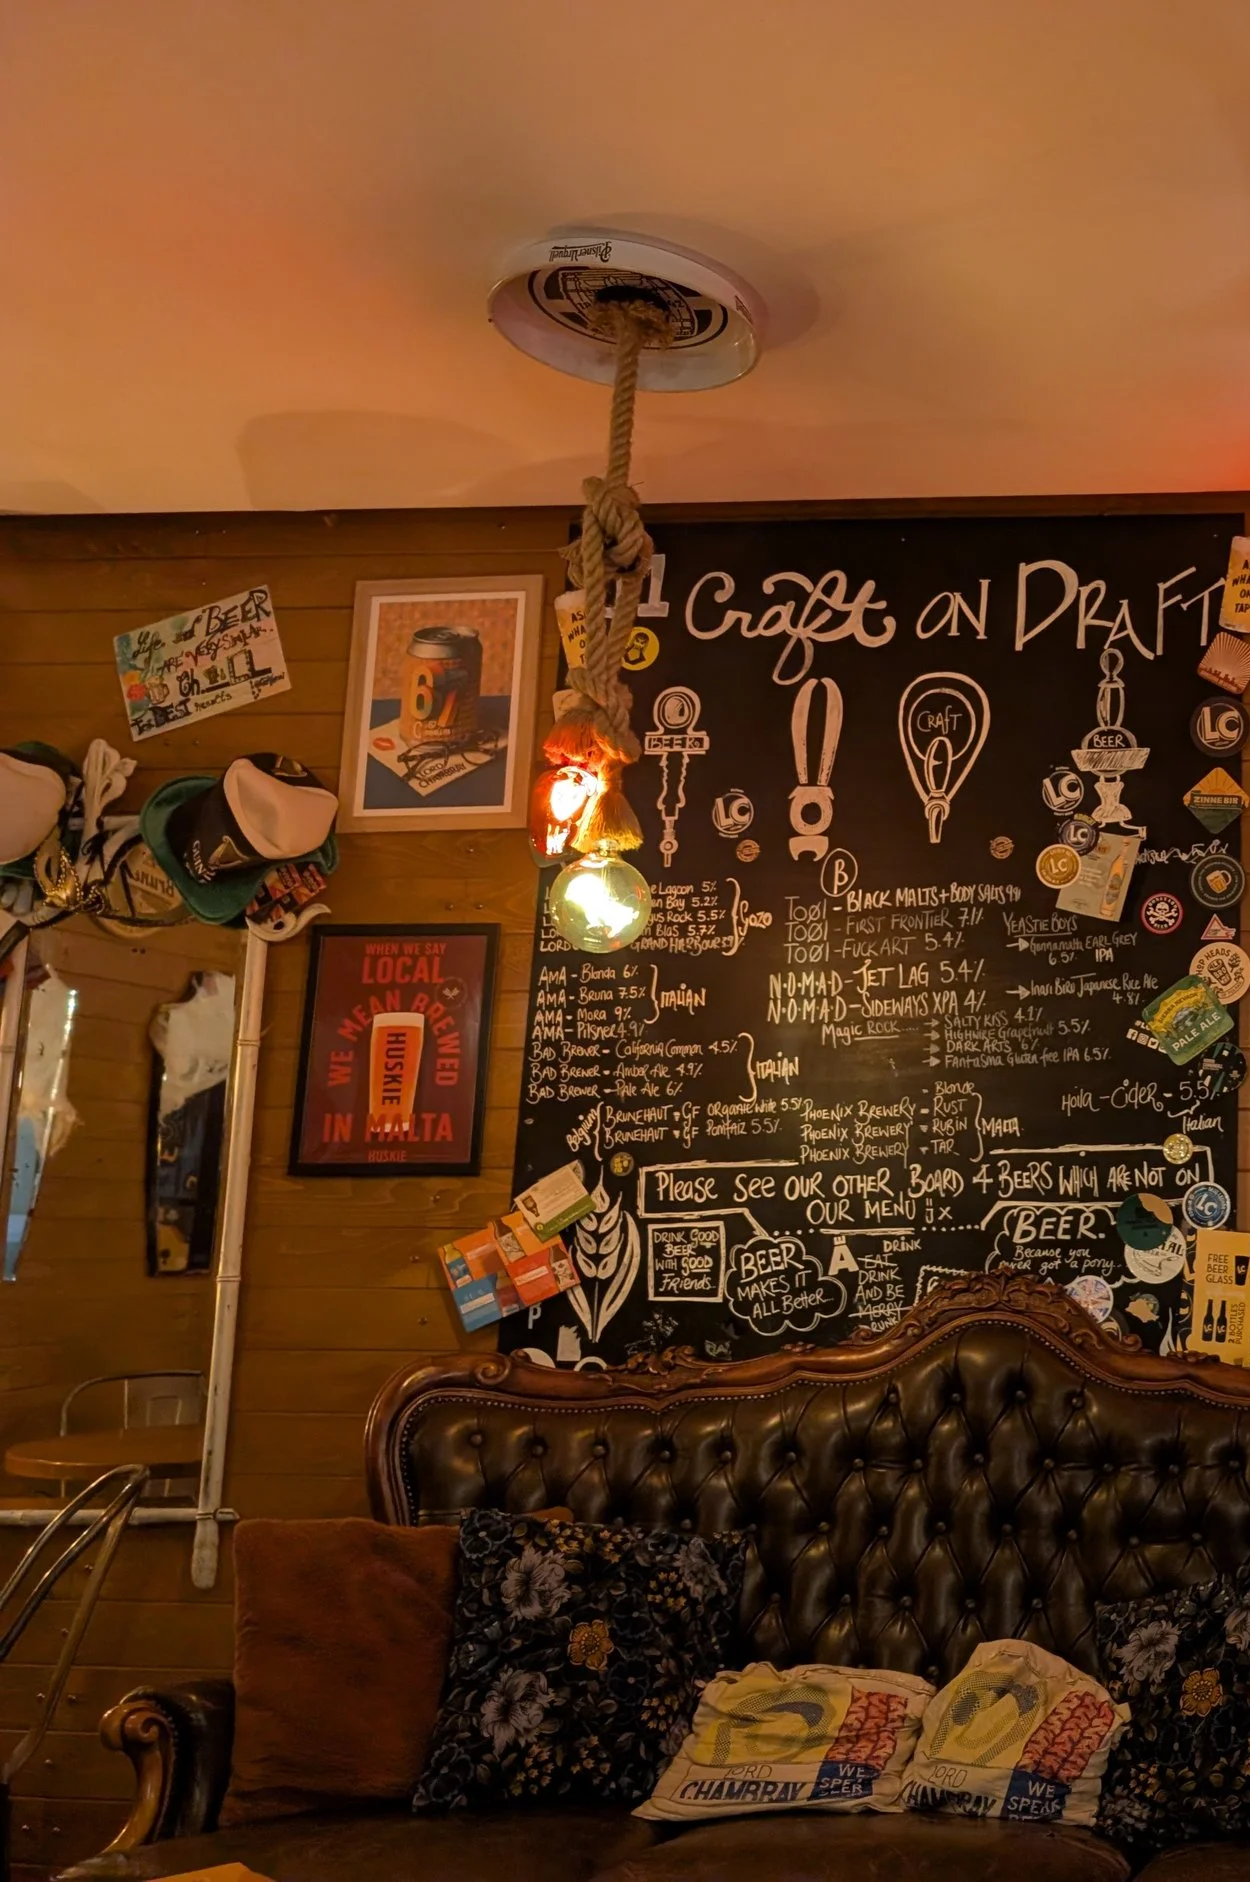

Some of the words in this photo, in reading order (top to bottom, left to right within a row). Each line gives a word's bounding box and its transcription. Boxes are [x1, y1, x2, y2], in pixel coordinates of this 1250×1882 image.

[549, 244, 579, 262] Urquell
[578, 241, 612, 263] Pilsner
[685, 569, 896, 684] Craft
[915, 578, 992, 639] ON
[1015, 560, 1226, 660] DRAFT
[1202, 705, 1240, 743] LC
[1094, 735, 1125, 748] BEER
[1043, 773, 1080, 808] LC
[714, 797, 751, 830] LC
[1067, 824, 1088, 842] LC
[1050, 857, 1067, 874] LC
[1085, 934, 1111, 949] EARL
[1111, 930, 1138, 947] GREY
[365, 943, 399, 956] WHEN
[403, 943, 419, 955] WE
[425, 943, 447, 955] SAY
[1094, 948, 1114, 963] IPA
[1205, 947, 1232, 960] HEADS
[362, 956, 445, 984] LOCAL
[852, 959, 895, 994] JET
[899, 962, 929, 989] LAG
[860, 991, 929, 1018] SIDEWAYS
[932, 989, 959, 1016] XPA
[337, 989, 400, 1042] MEAN
[411, 992, 462, 1086] BREWED
[1171, 1027, 1200, 1052] PALE
[1199, 1011, 1222, 1031] ALE
[328, 1050, 353, 1087] WE
[382, 1032, 407, 1106] HUSKIE
[932, 1096, 968, 1117] RUST
[322, 1113, 353, 1143] IN
[364, 1113, 453, 1143] MALTA
[368, 1150, 407, 1163] HUSKIE
[930, 1138, 960, 1156] TAR
[783, 1170, 826, 1201] OUR
[832, 1166, 895, 1198] OTHER
[907, 1163, 965, 1198] BOARD
[997, 1159, 1054, 1198] BEERS
[1058, 1164, 1100, 1198] WHICH
[1106, 1163, 1133, 1192] ARE
[1133, 1160, 1168, 1189] NOT
[1174, 1162, 1201, 1186] ON
[806, 1198, 856, 1226] OUR
[864, 1199, 917, 1224] MENU
[654, 1231, 685, 1244] DRINK
[663, 1243, 696, 1258] BEER
[1068, 1247, 1092, 1264] you
[1207, 1253, 1229, 1265] FREE
[739, 1243, 805, 1284] BEER
[1040, 1259, 1061, 1277] got
[1206, 1263, 1229, 1274] BEER
[737, 1275, 791, 1302] MAKES
[792, 1269, 813, 1289] IT
[857, 1269, 902, 1285] DRINK
[1205, 1273, 1234, 1285] GLASS
[886, 1283, 905, 1299] BE
[752, 1300, 783, 1320] ALL
[1229, 1303, 1239, 1337] BOTTLES
[1236, 1302, 1246, 1345] PURCHASED
[725, 1762, 772, 1781] LORD
[838, 1762, 866, 1778] WE
[1027, 1782, 1056, 1799] WE
